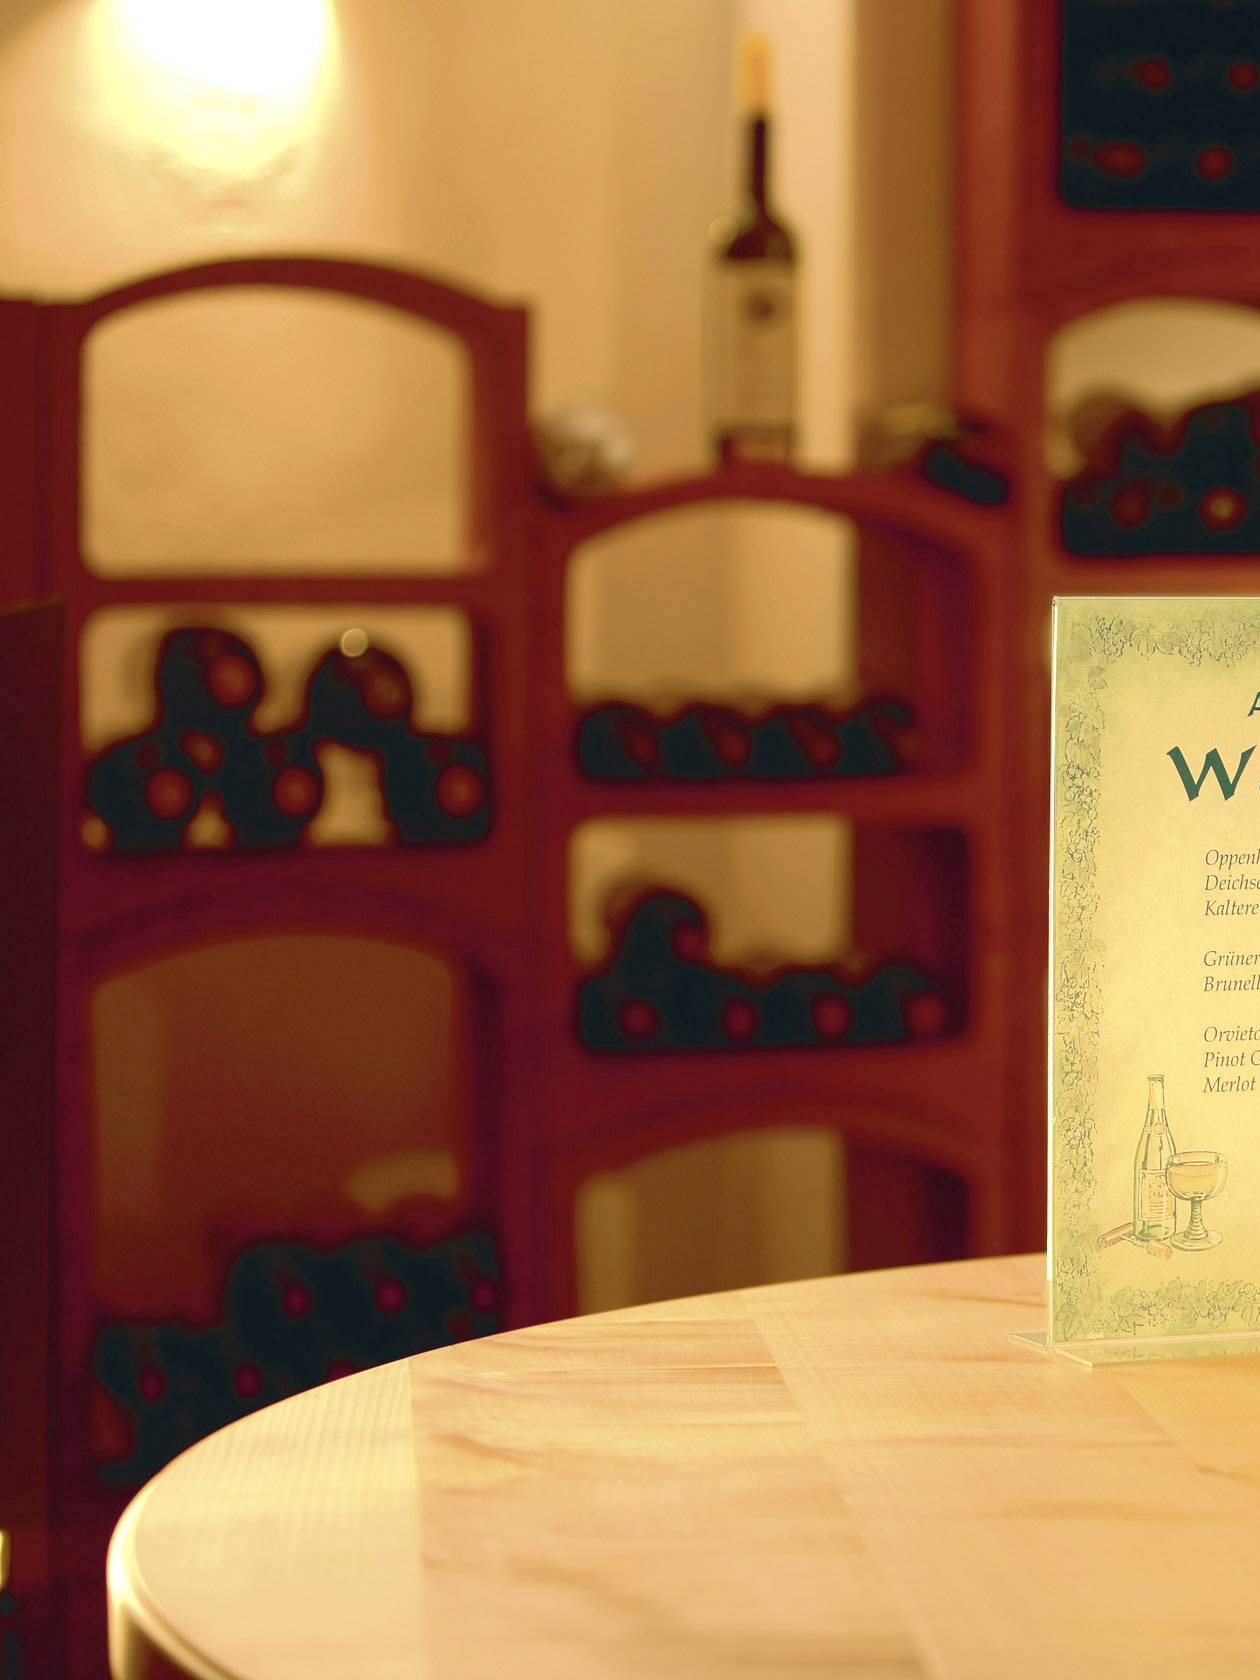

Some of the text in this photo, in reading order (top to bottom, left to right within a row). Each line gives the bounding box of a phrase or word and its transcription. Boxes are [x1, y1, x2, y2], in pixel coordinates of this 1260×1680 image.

[1203, 949, 1260, 968] Grüner
[1203, 1051, 1246, 1069] Pinot
[1203, 1076, 1256, 1094] Merlot
